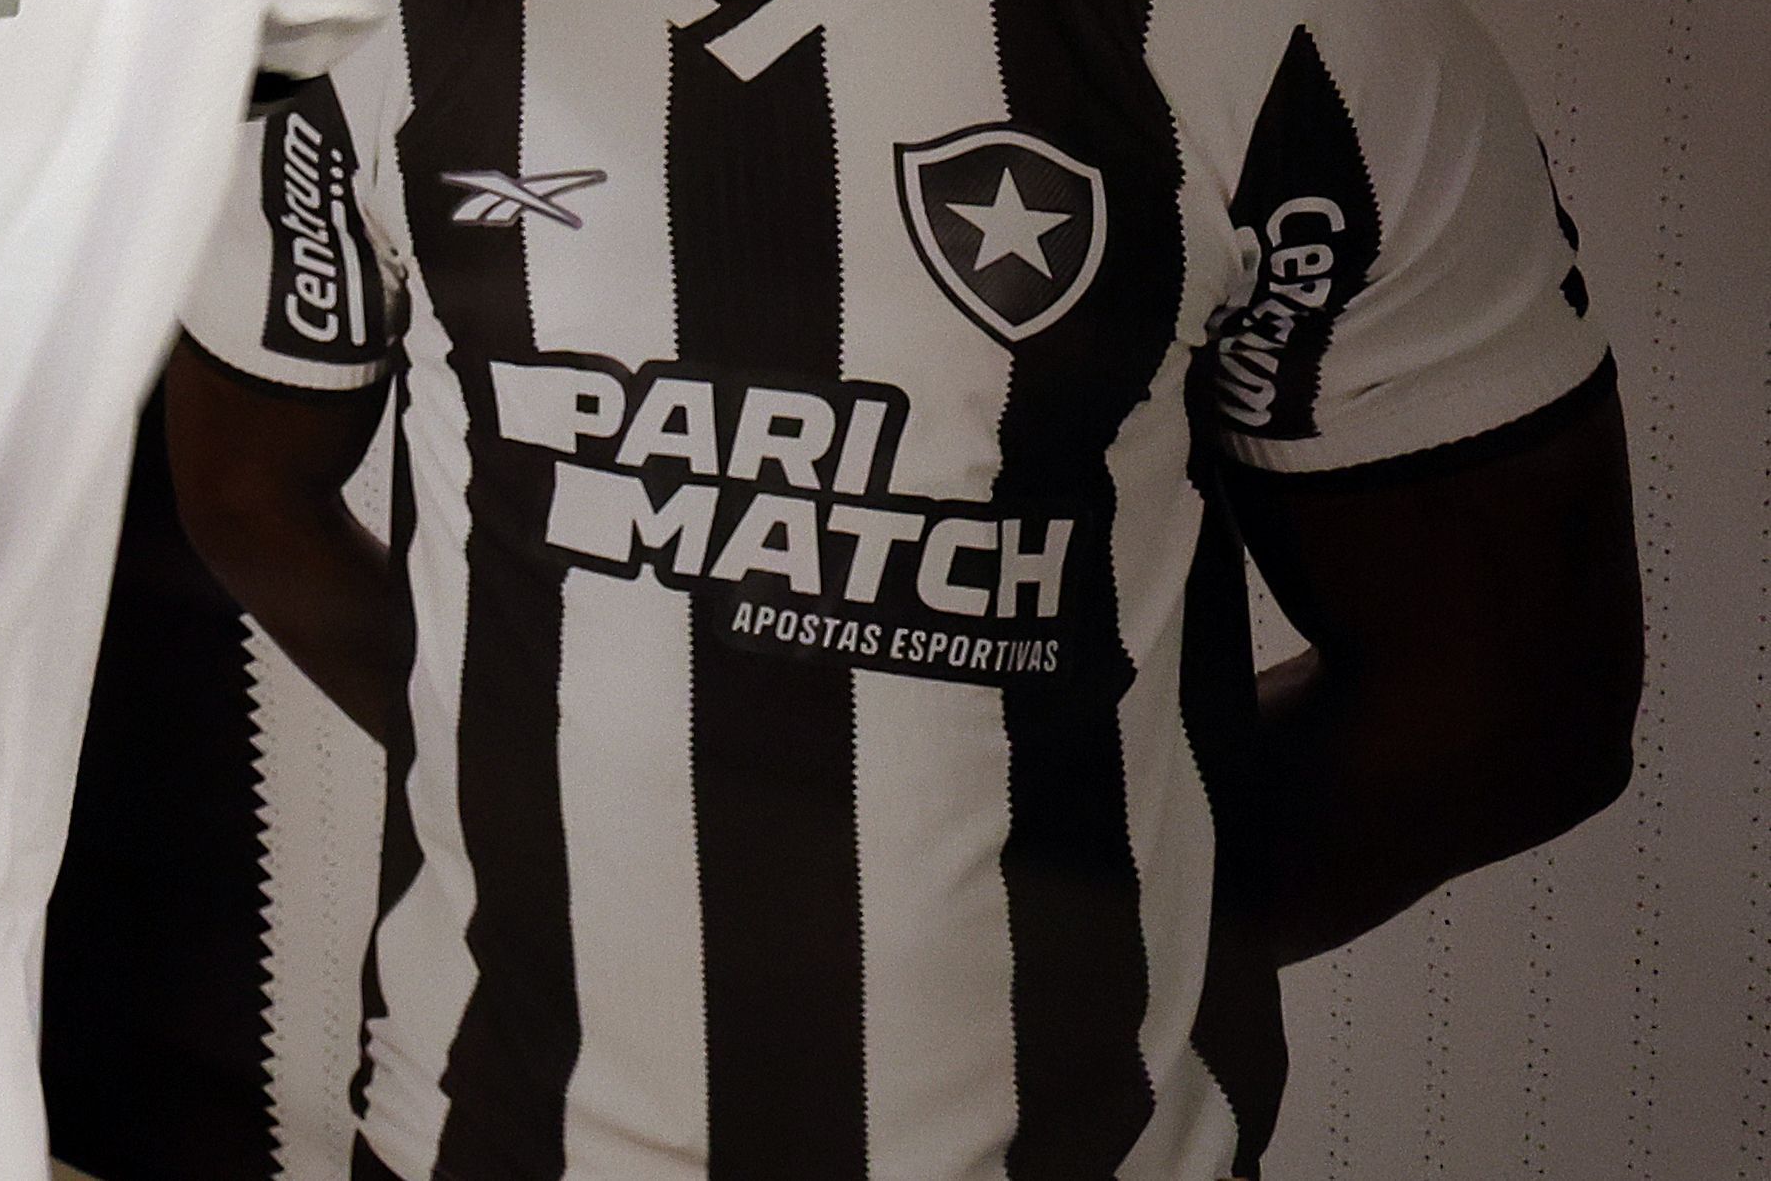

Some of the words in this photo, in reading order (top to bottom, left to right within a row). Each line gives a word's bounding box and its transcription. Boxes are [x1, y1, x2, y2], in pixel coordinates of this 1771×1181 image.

[281, 112, 339, 342] Centrum
[490, 361, 887, 495] PARI
[545, 461, 1074, 618] MATCH
[731, 602, 882, 655] APOSTAS
[889, 627, 1060, 672] ESPORTIVAS
